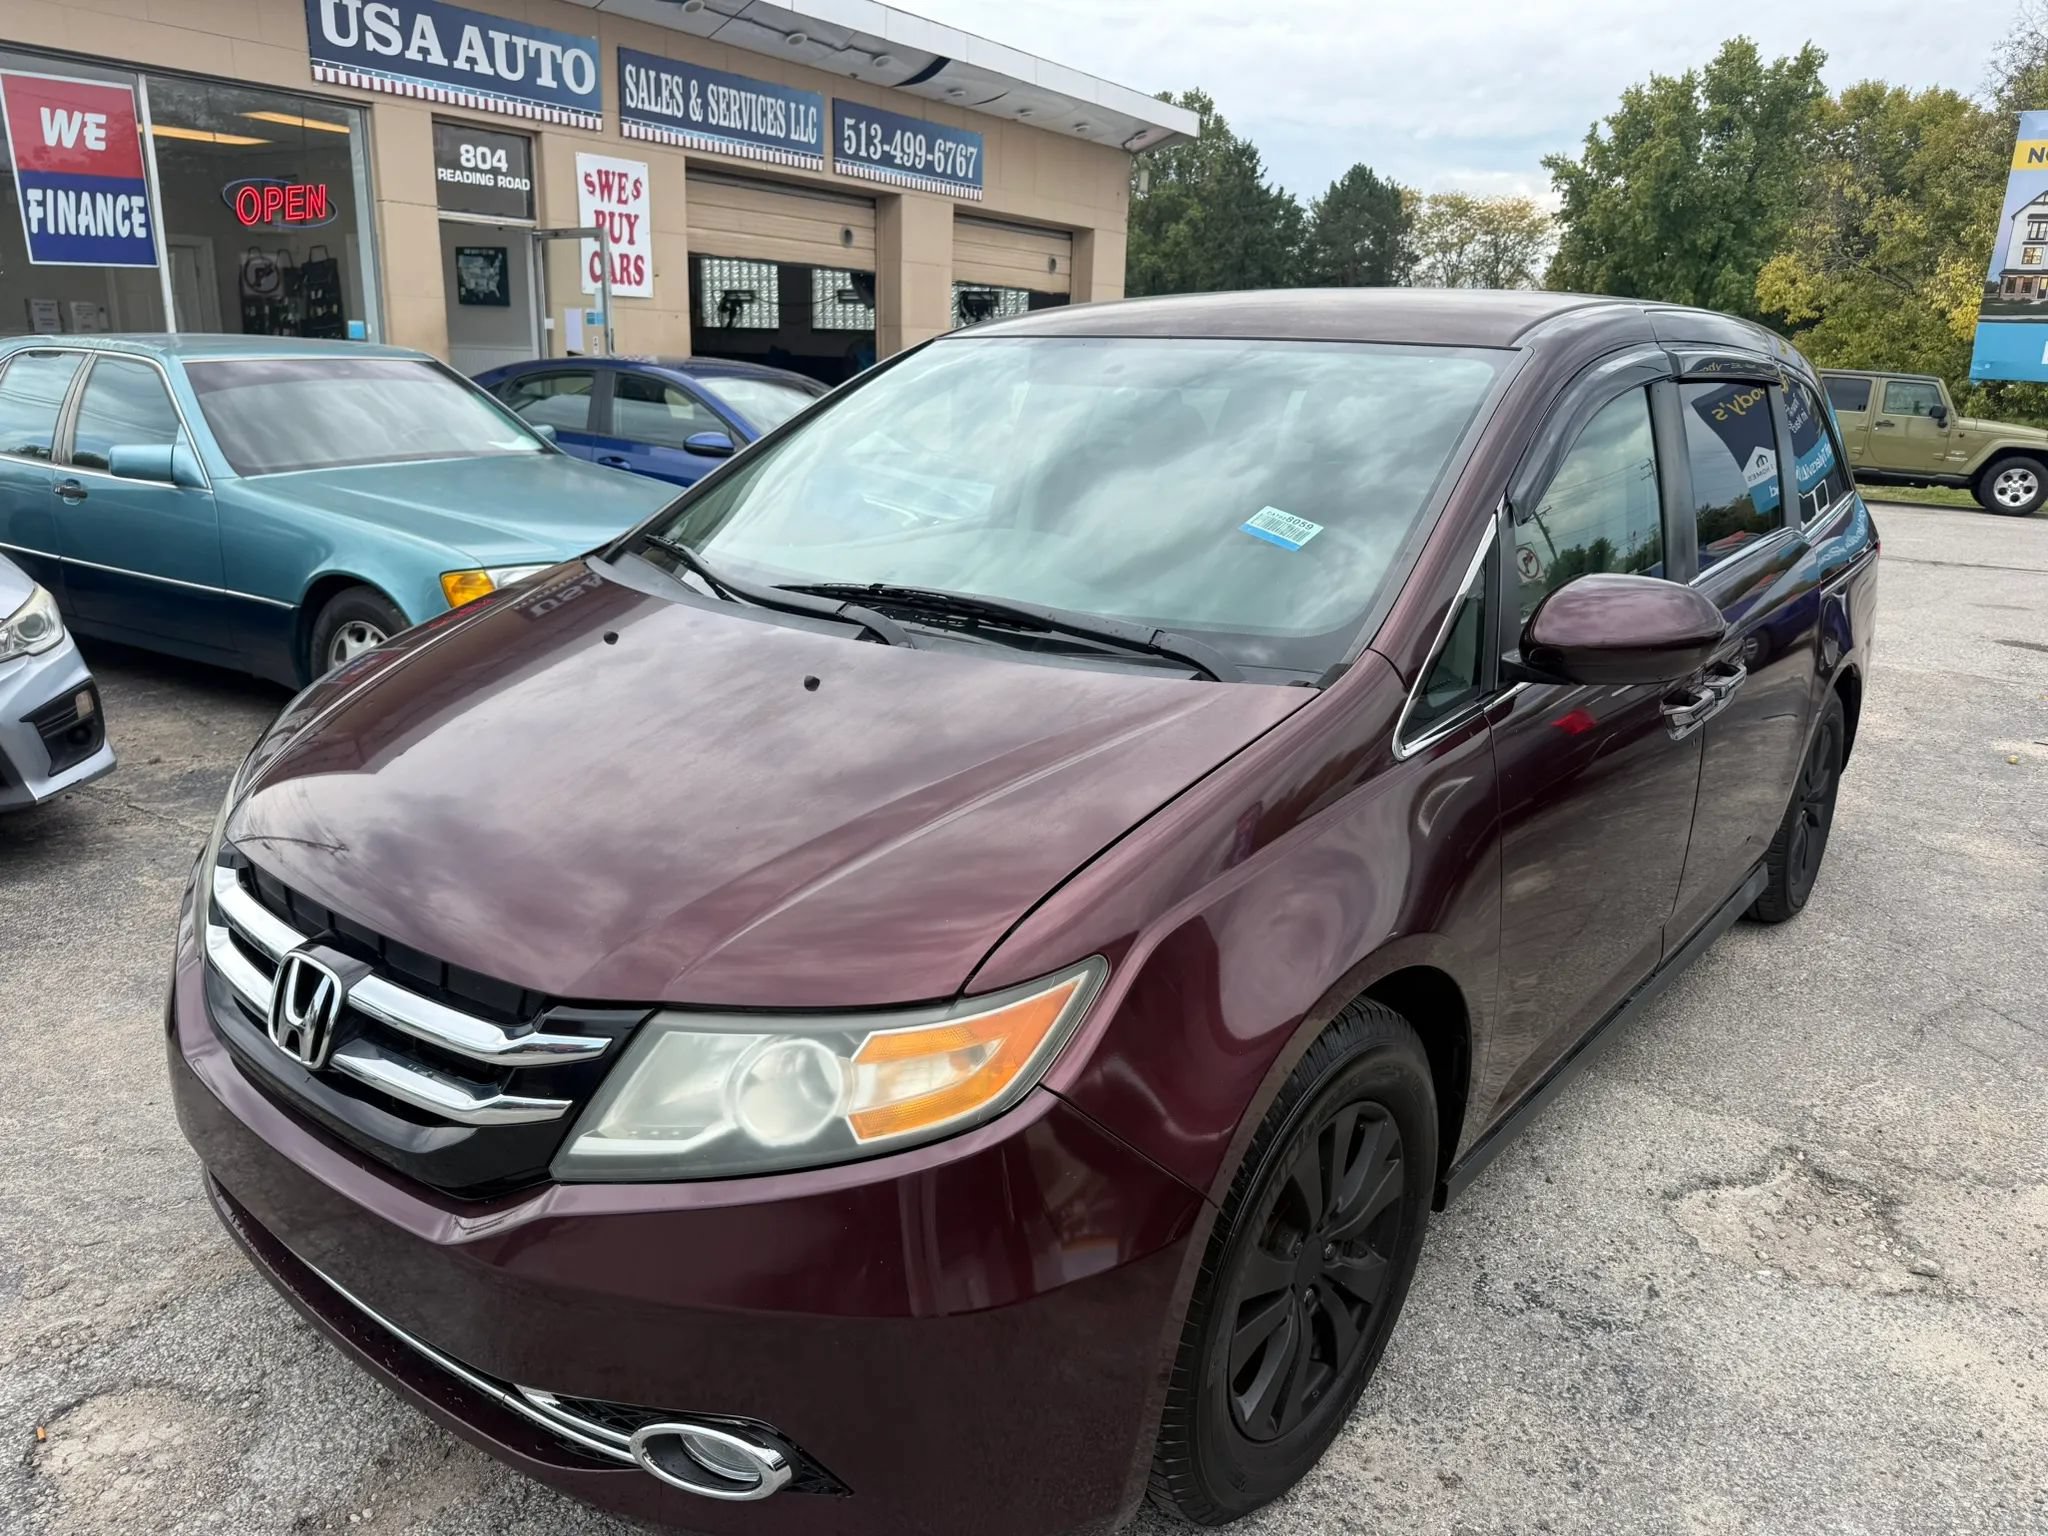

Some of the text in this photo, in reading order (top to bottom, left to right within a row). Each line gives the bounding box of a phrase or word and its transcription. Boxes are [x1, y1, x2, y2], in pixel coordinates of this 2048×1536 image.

[320, 0, 597, 96] USA AUTO
[624, 63, 818, 146] SALES & SERVICES LLC
[39, 106, 108, 152] WE
[843, 117, 979, 180] 513-499-6767
[459, 143, 509, 173] 804
[2027, 146, 2048, 164] N
[437, 167, 531, 191] READING ROAD
[26, 188, 148, 239] FINANCE
[235, 183, 327, 227] OPEN
